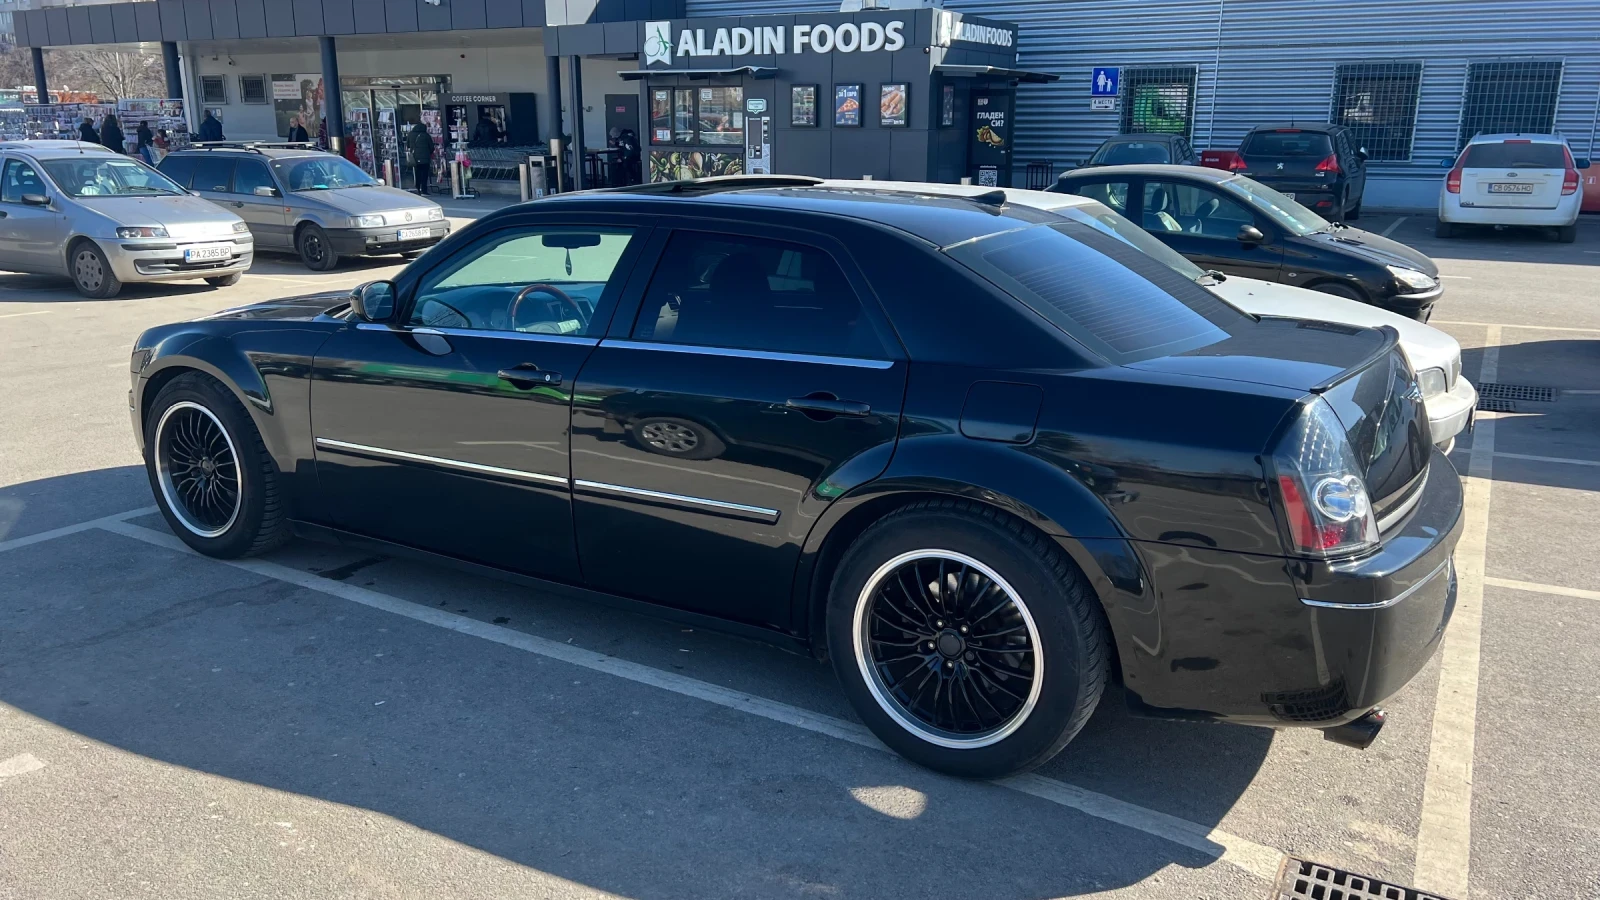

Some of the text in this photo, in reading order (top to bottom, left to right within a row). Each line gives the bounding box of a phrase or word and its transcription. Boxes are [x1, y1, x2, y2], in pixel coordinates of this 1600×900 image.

[676, 20, 905, 57] ALADIN FOODS
[954, 21, 1013, 47] ALADIN FOODS
[976, 112, 1004, 120] ГЛАДЕН
[1504, 184, 1520, 192] 0576
[190, 247, 230, 259] PA 2385 BP
